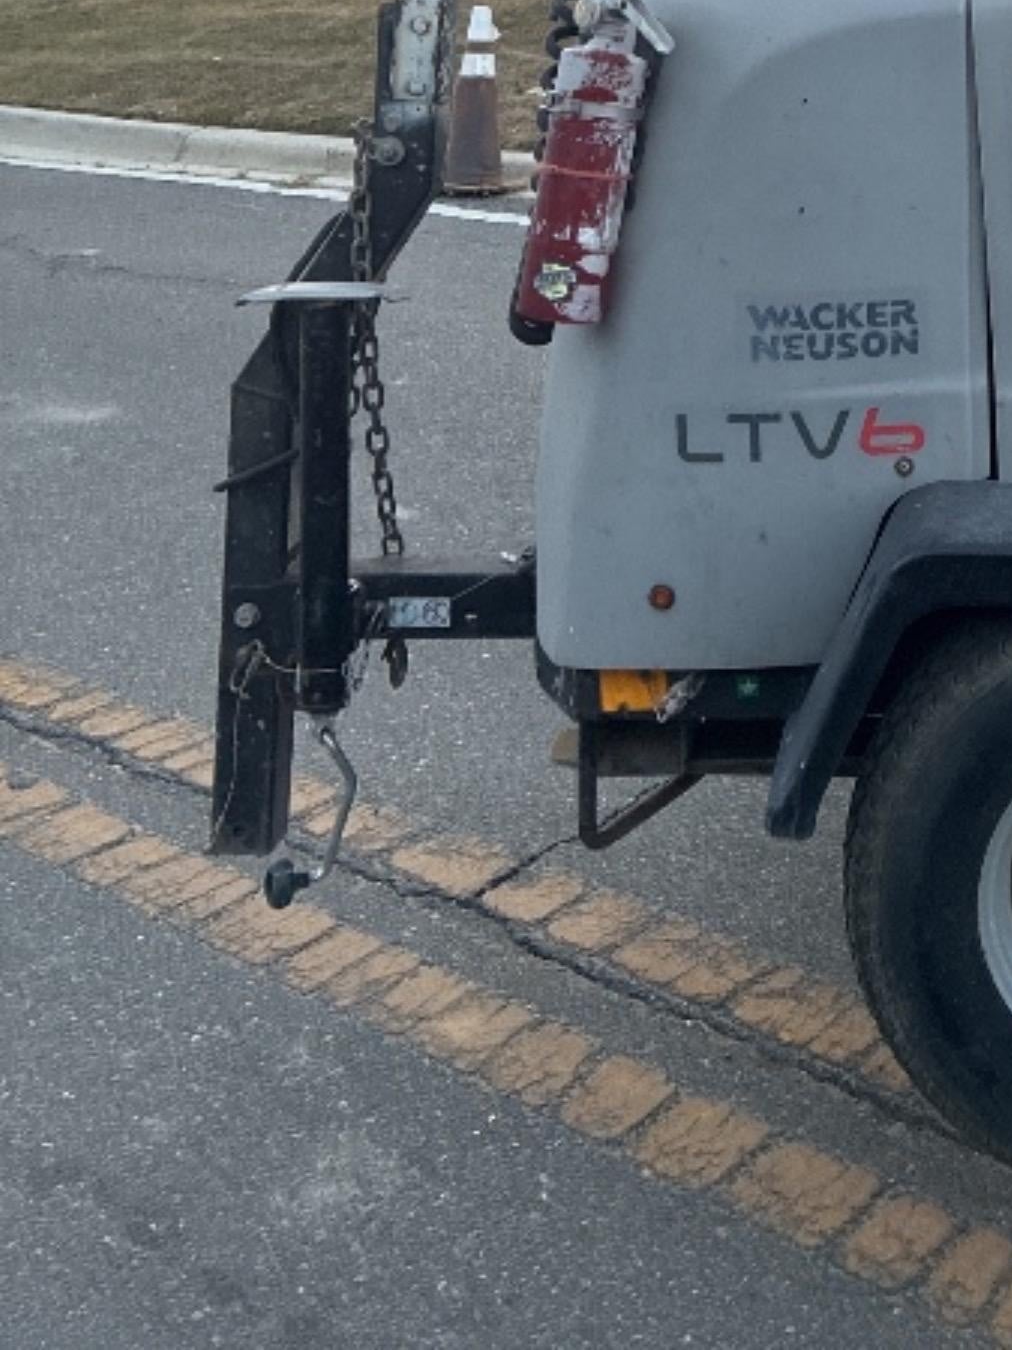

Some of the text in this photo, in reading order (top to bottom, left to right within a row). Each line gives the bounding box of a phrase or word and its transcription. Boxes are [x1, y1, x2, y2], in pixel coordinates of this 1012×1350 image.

[747, 300, 919, 331] WACKER
[751, 328, 919, 362] NEUSON
[676, 407, 924, 462] LTV6
